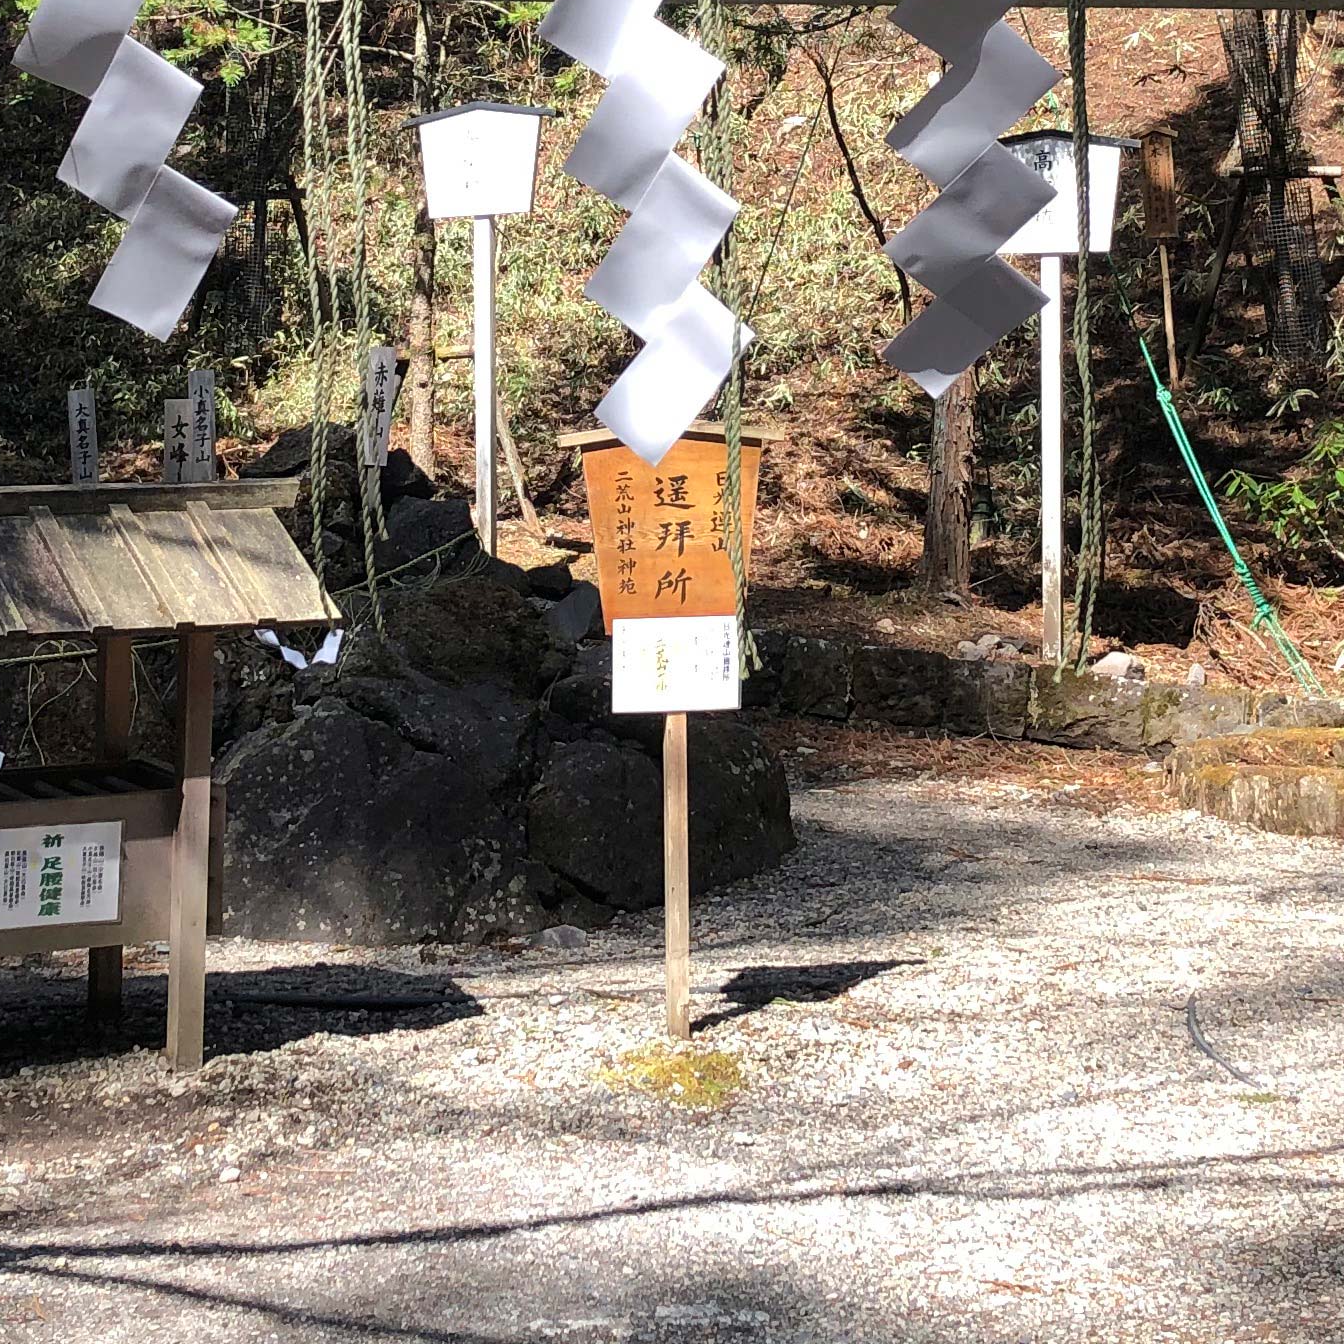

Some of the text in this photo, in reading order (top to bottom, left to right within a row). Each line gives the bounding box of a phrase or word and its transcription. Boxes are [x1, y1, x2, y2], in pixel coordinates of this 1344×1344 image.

[75, 402, 93, 480] 大真名子山
[169, 414, 189, 482] 女峰
[193, 385, 210, 464] 小真名子山
[614, 471, 637, 595] 二荒山神社神苑
[653, 474, 696, 605] 遥拝所
[37, 833, 65, 917] 祈 足腰健康
